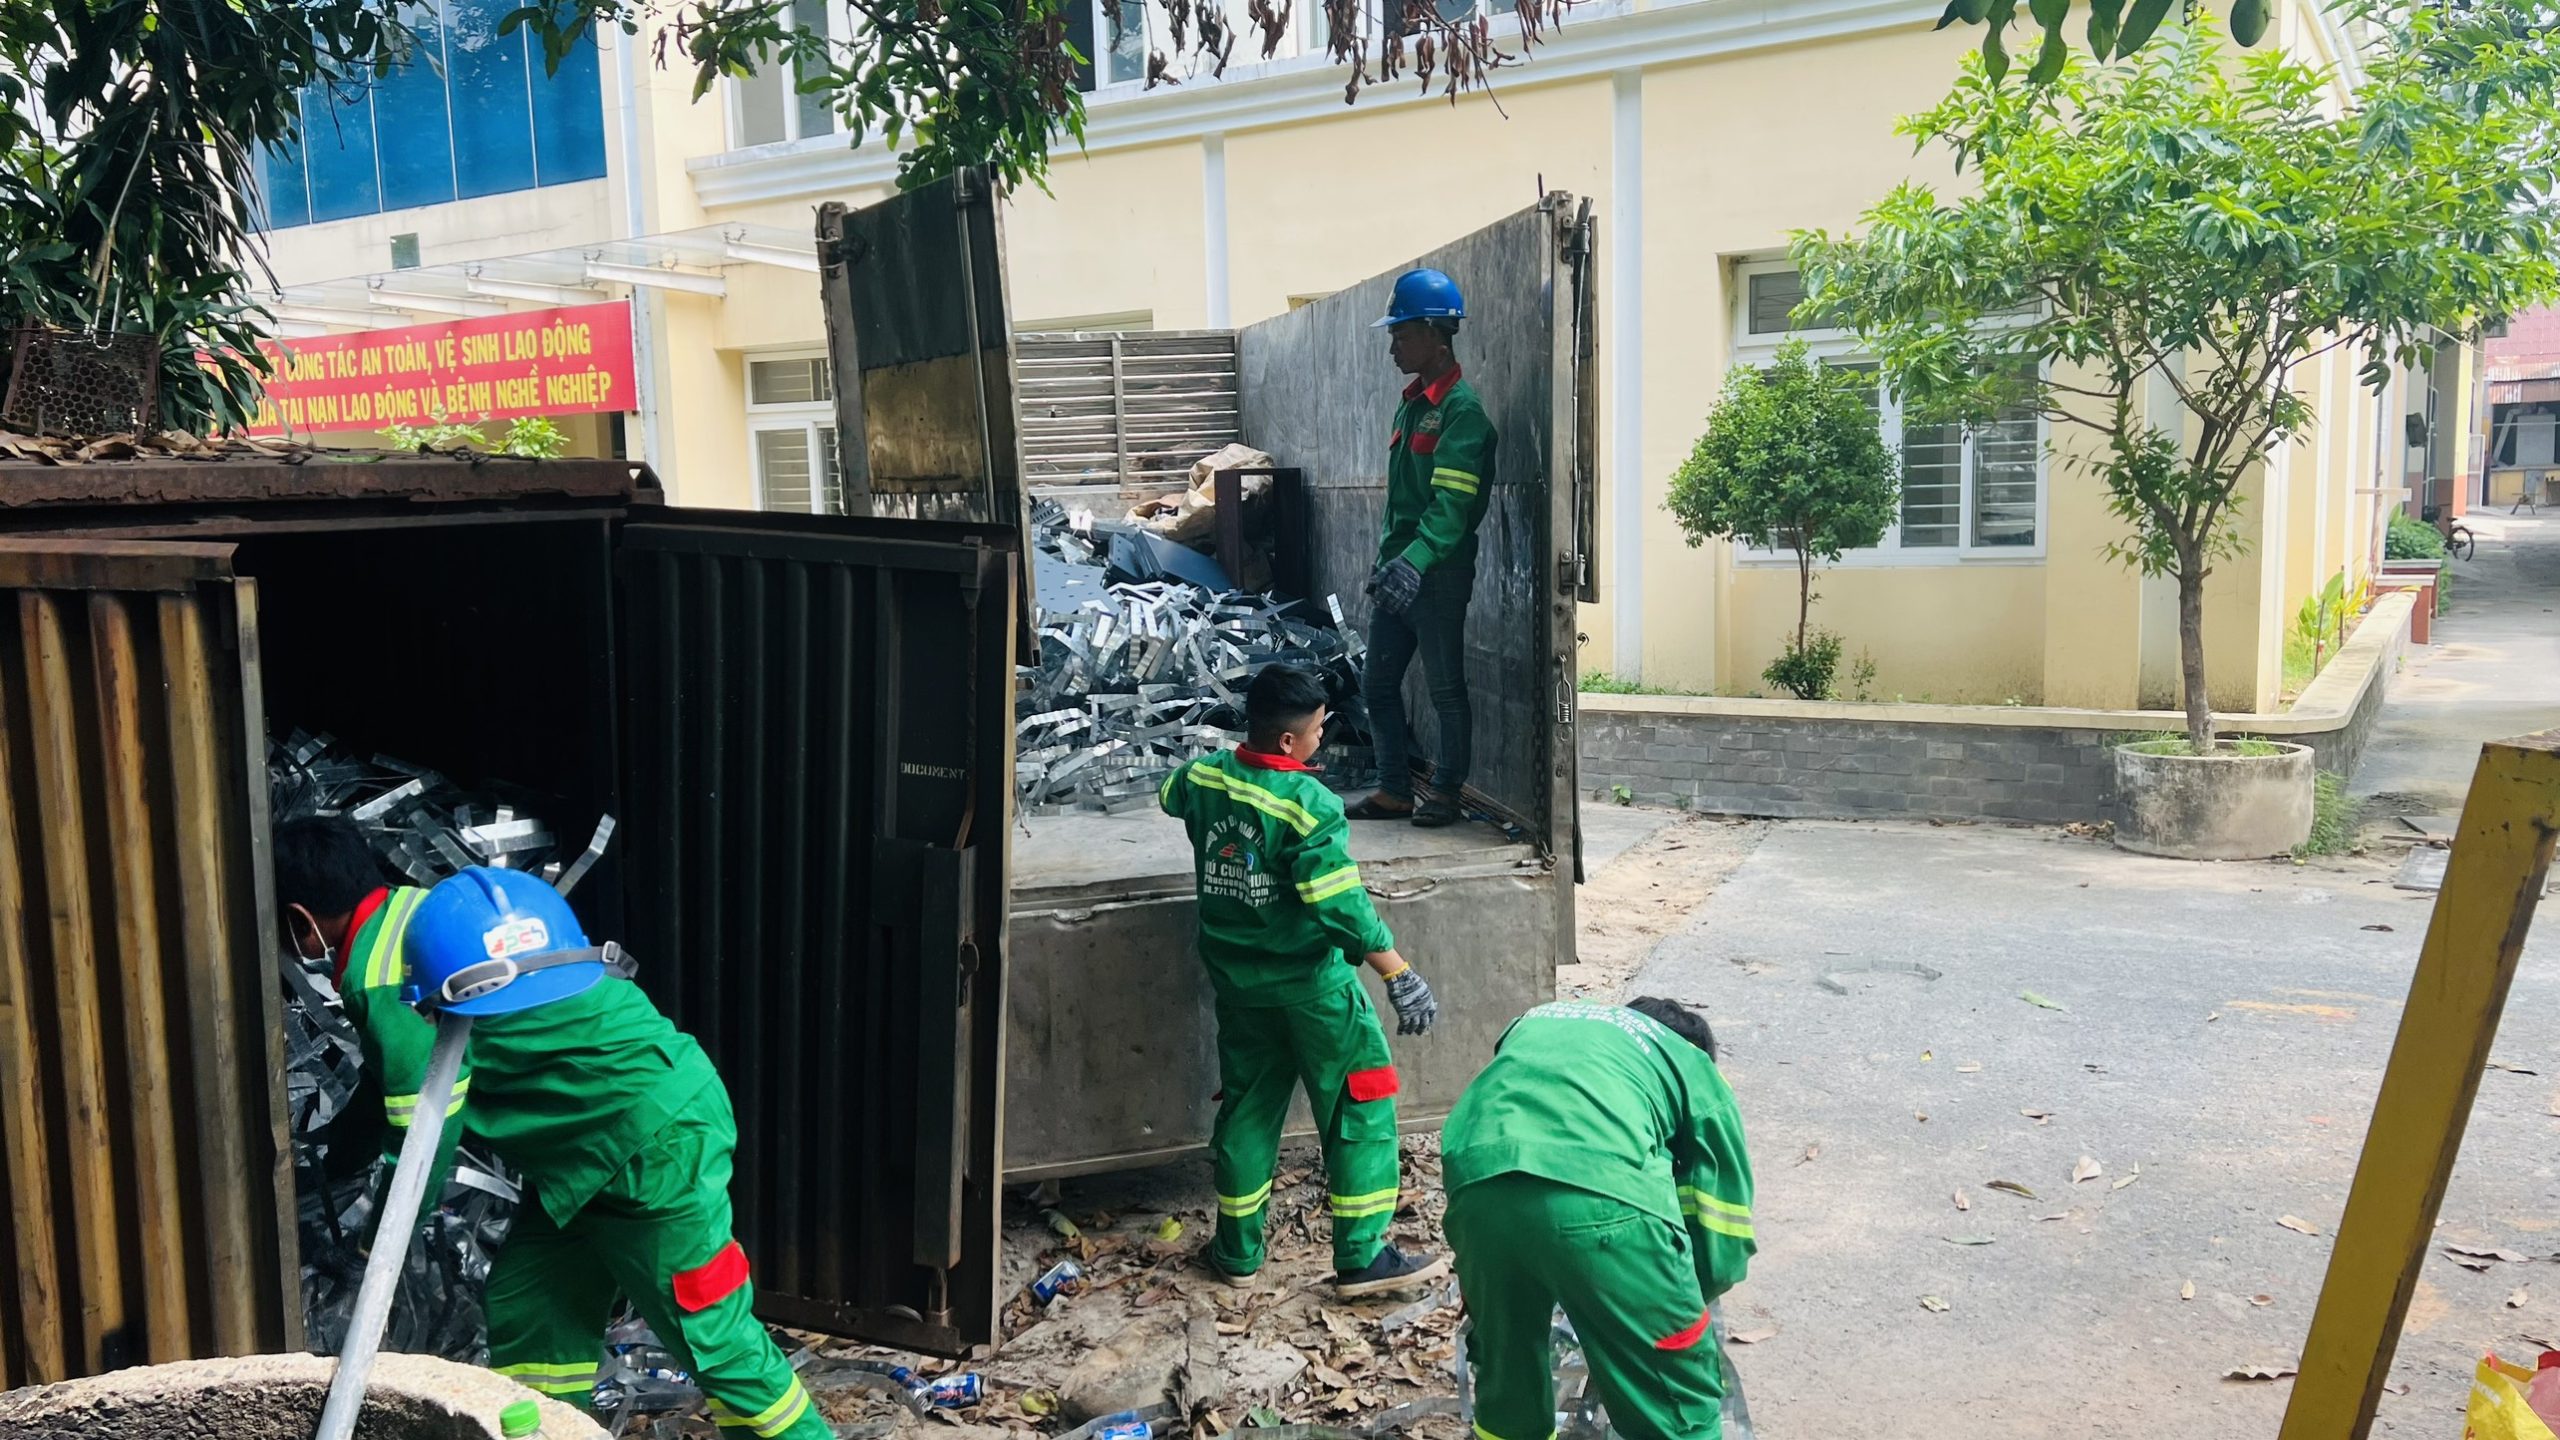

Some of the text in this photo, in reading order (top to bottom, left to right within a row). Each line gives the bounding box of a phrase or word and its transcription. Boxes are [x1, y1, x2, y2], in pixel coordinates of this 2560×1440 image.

[284, 346, 325, 383] CÔNG
[326, 342, 358, 379] TÁC
[361, 346, 382, 376] AN
[384, 335, 432, 375] TOÀN,
[434, 330, 457, 374] VỆ
[461, 332, 500, 366] SINH
[504, 328, 538, 361] LAO
[541, 317, 591, 363] ĐỘNG
[279, 397, 305, 425] TAI
[306, 395, 339, 429] NẠN
[341, 392, 371, 422] LAO
[374, 383, 418, 425] ĐỘNG
[419, 378, 442, 417] VÀ
[446, 376, 492, 419] BỆNH
[495, 363, 541, 410] NGHỀ
[546, 363, 612, 410] NGHIỆP
[900, 762, 966, 780] DOCUMENT
